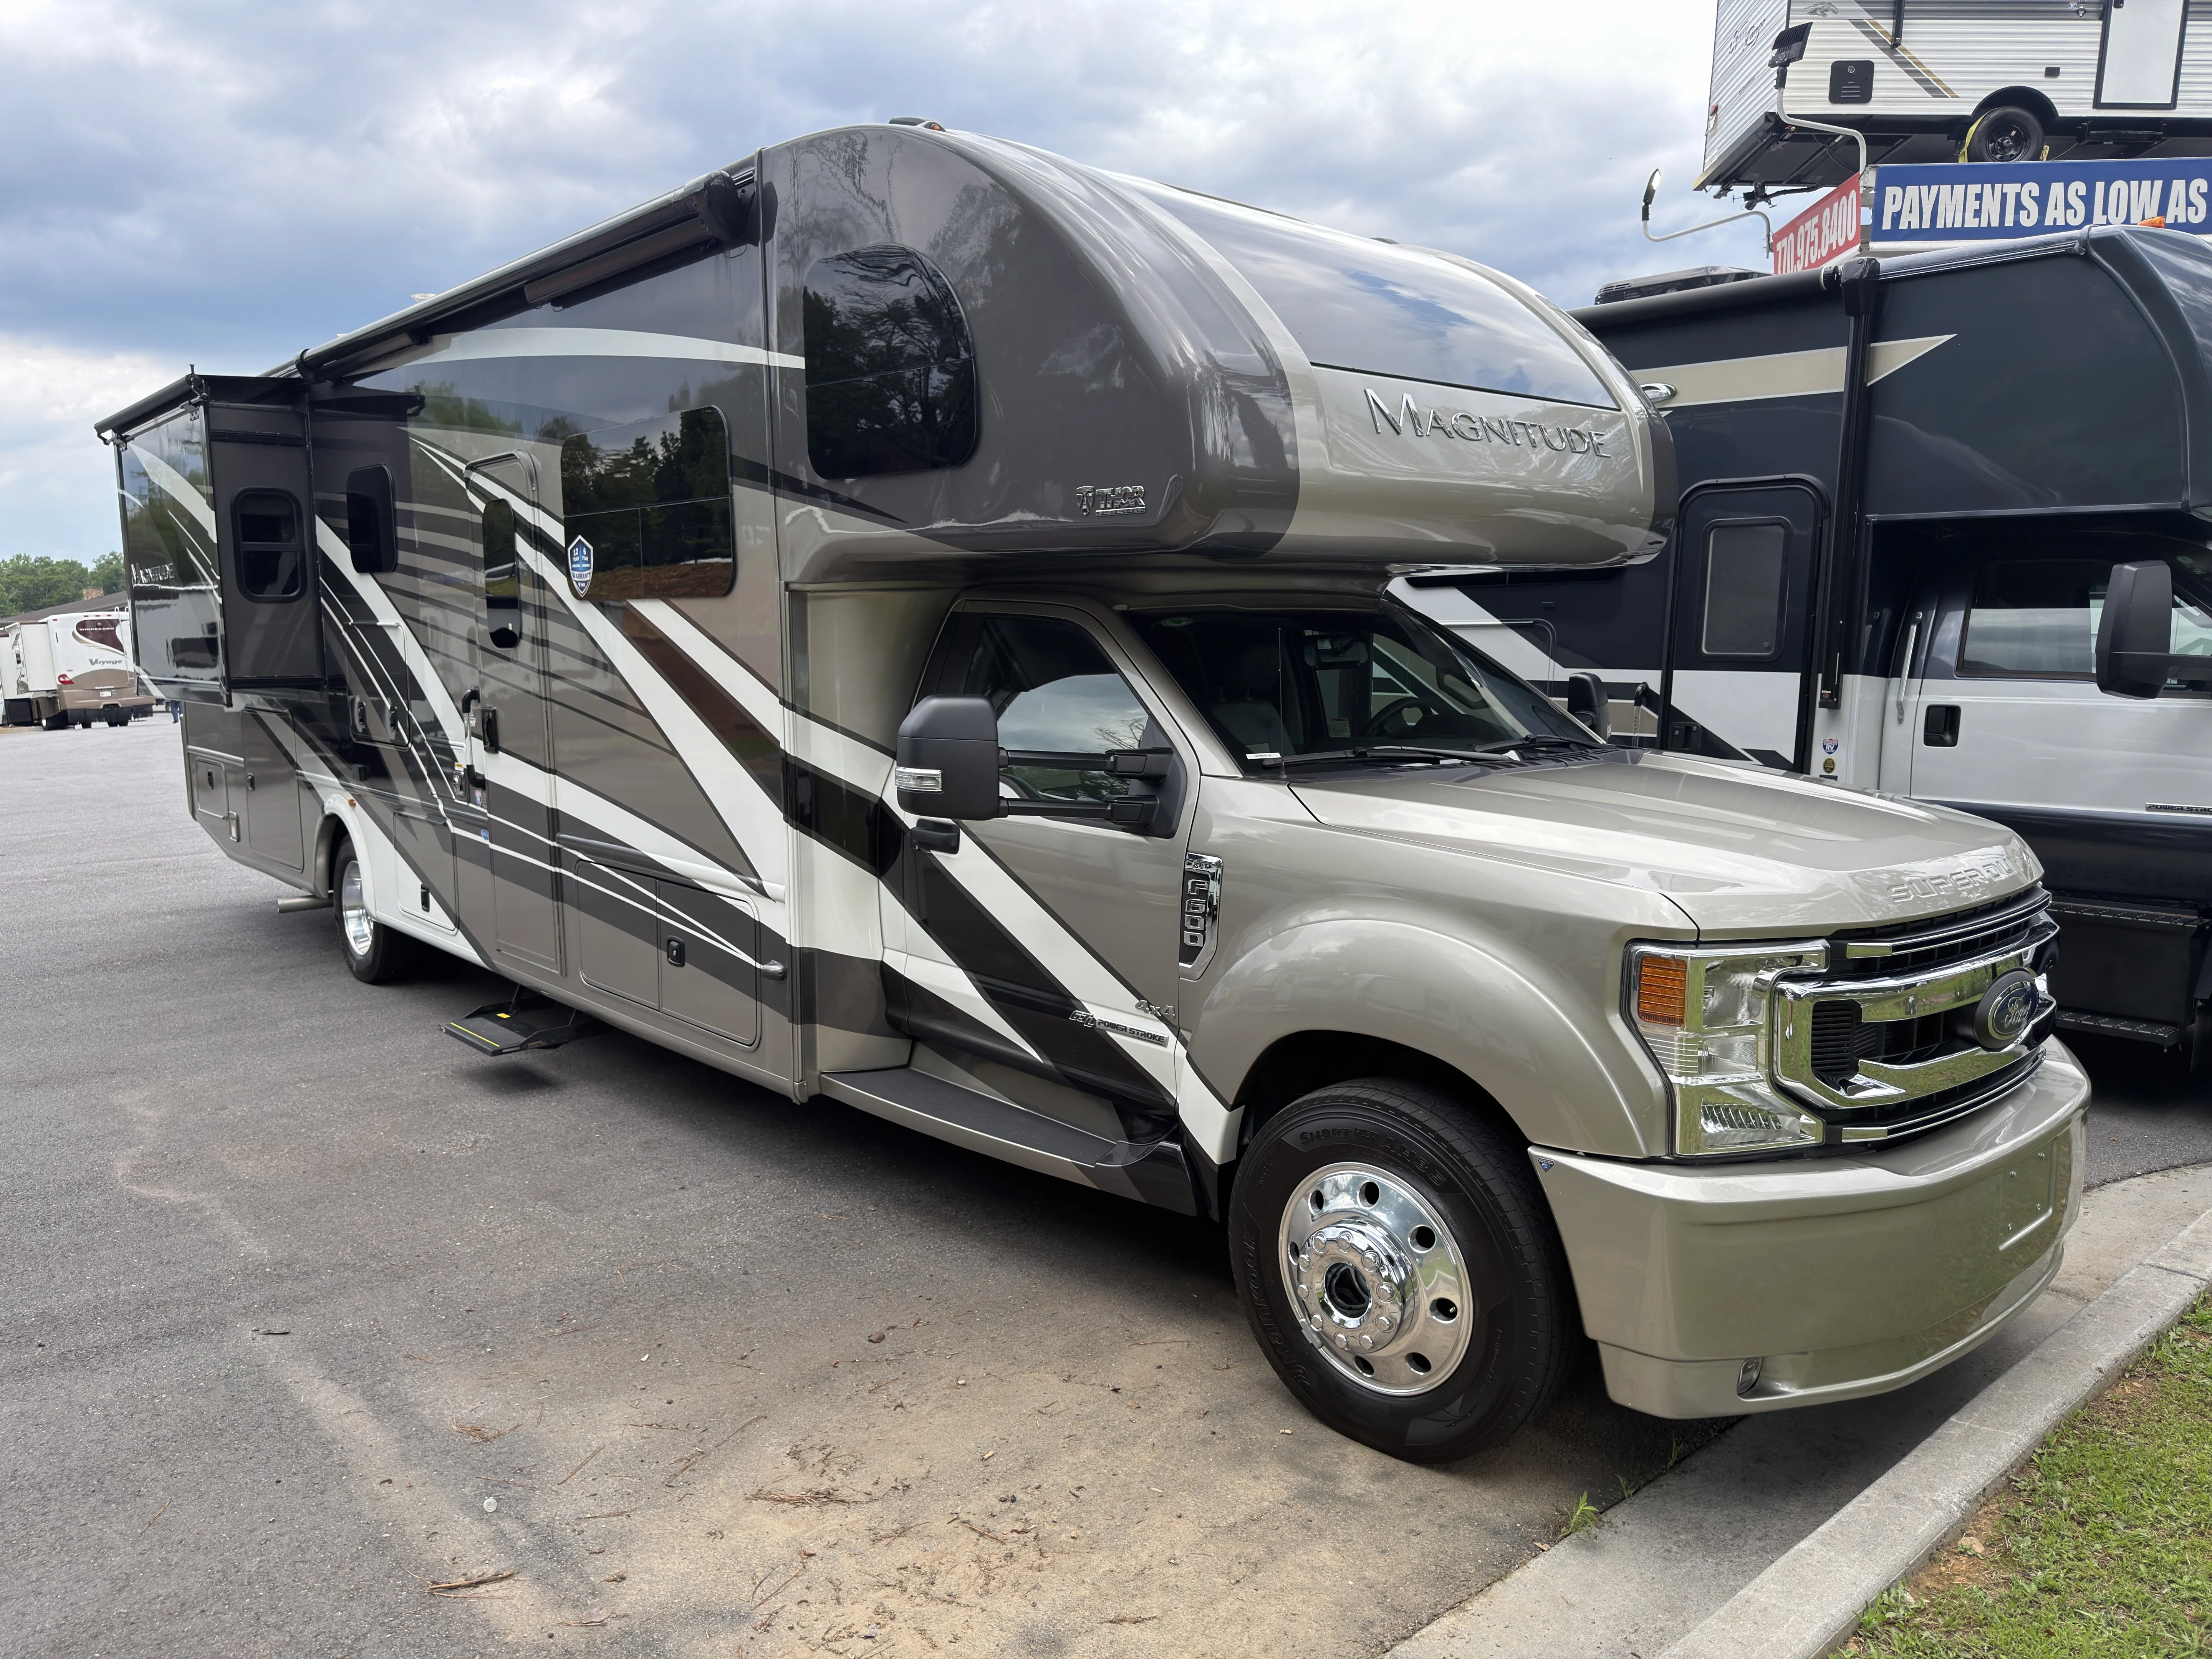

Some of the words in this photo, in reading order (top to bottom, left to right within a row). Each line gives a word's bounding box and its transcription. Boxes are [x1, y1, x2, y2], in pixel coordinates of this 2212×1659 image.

[1882, 182, 2039, 230] PAYMENTS
[2045, 181, 2086, 226] AS
[2093, 179, 2163, 224] LOW
[2167, 178, 2208, 224] AS
[1776, 189, 1856, 275] 770.975.8400
[1364, 388, 1611, 458] MAGNITUDE
[1096, 485, 1146, 509] THOR
[573, 548, 579, 556] 12
[583, 547, 586, 556] 6
[1887, 868, 1988, 902] SUPER
[1184, 879, 1209, 947] F600
[2002, 994, 2032, 1029] Ford
[1098, 1019, 1128, 1033] POWER
[1129, 1027, 1165, 1043] STROKE
